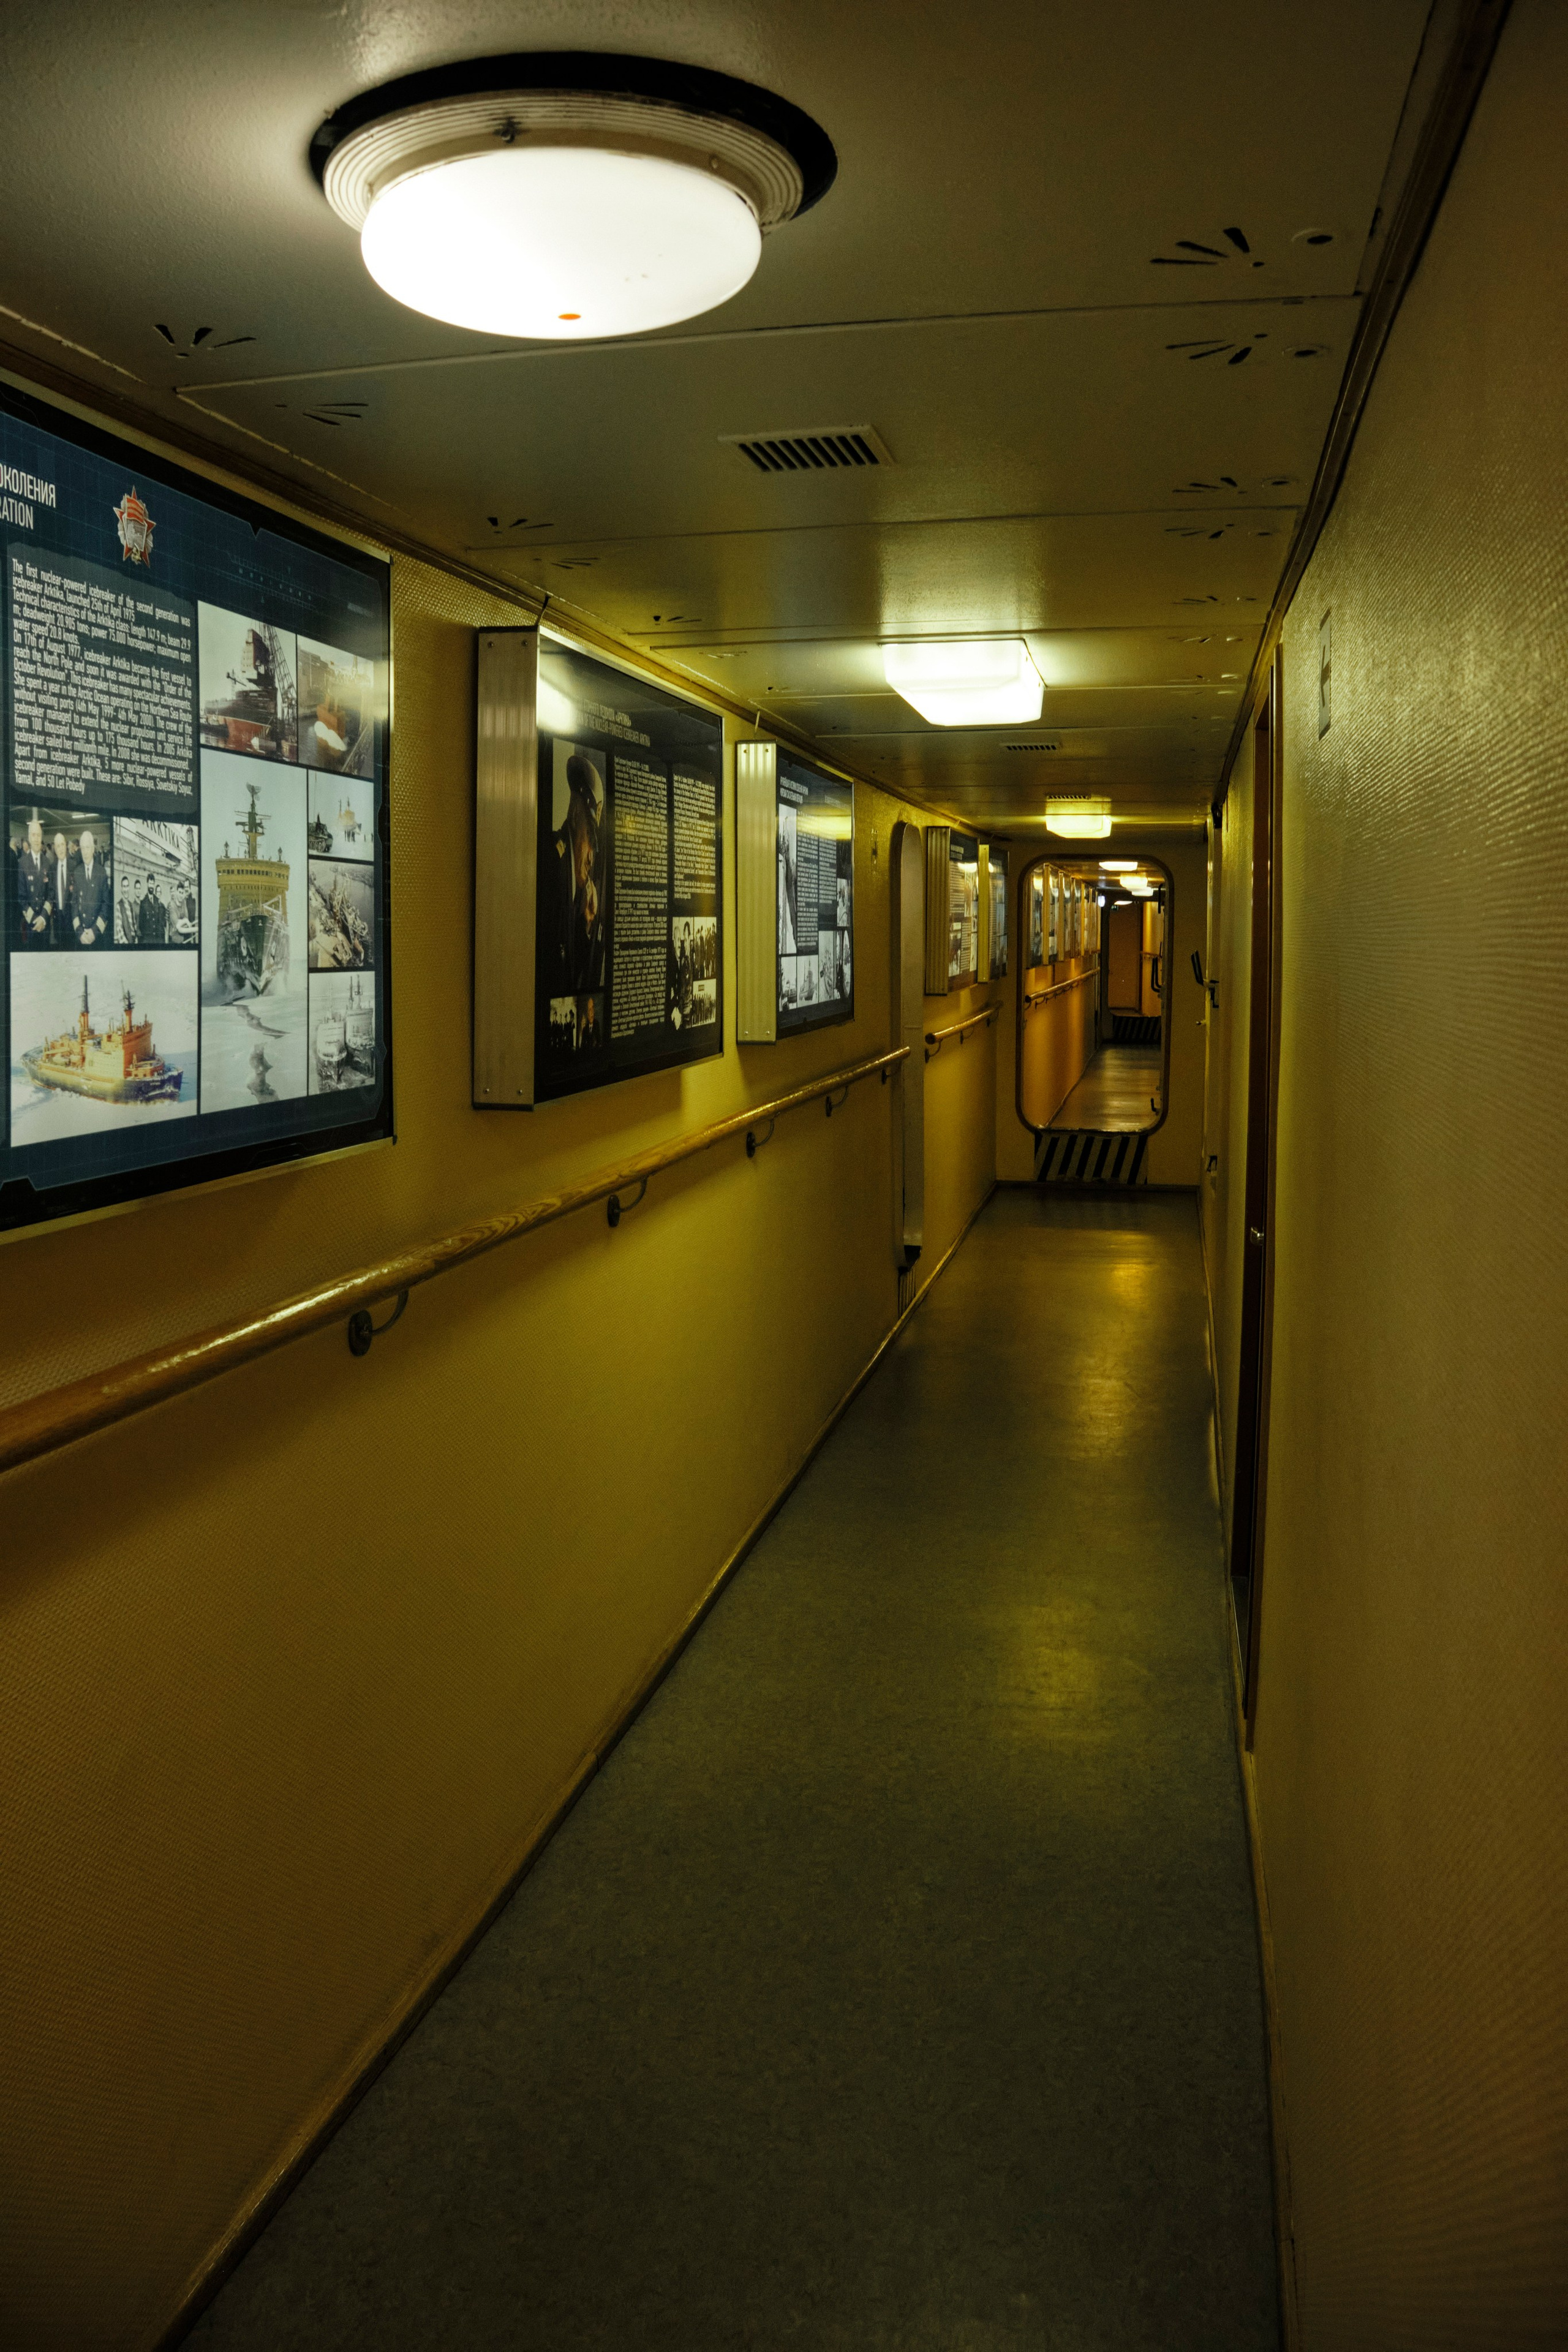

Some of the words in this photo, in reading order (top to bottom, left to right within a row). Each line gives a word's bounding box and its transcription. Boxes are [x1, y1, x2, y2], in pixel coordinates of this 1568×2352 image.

[0, 495, 33, 530] ATION
[12, 558, 23, 574] The
[26, 562, 37, 579] first
[40, 570, 86, 594] nuclear-powered
[89, 583, 115, 603] icebreaker
[118, 594, 123, 606] of
[137, 601, 153, 615] second
[155, 608, 178, 624] generation
[181, 616, 190, 627] was
[12, 572, 42, 594] icebreaker
[66, 589, 89, 608] launched
[91, 597, 102, 612] 25th
[104, 601, 108, 614] of
[110, 603, 121, 619] April
[123, 607, 134, 622] 1975
[13, 586, 39, 606] Technical
[40, 595, 79, 618] characteristics
[80, 608, 86, 620] of
[97, 611, 115, 628] Arktika
[130, 622, 146, 638] length
[147, 627, 159, 641] 147.9
[168, 633, 179, 647] beam
[181, 637, 190, 650] 29.9
[13, 617, 29, 631] water
[31, 622, 48, 636] speed
[50, 624, 61, 640] 20.8
[62, 628, 79, 644] knots.
[23, 603, 55, 626] deadweight
[57, 613, 75, 630] 20.905
[91, 626, 107, 639] power
[180, 651, 190, 663] open
[13, 628, 21, 643] On
[24, 631, 36, 647] 17th
[39, 636, 44, 649] of
[47, 638, 65, 655] August
[84, 647, 110, 666] icebreaker
[112, 655, 129, 671] Arktika
[131, 660, 149, 676] became
[160, 668, 170, 681] first
[171, 673, 185, 685] vessel
[187, 676, 191, 686] to
[13, 646, 29, 659] reach
[32, 648, 41, 662] the
[43, 650, 59, 666] North
[61, 655, 72, 669] Pole
[74, 660, 84, 673] and
[86, 664, 98, 676] soon
[106, 669, 116, 680] was
[141, 676, 151, 688] with
[178, 685, 183, 696] of
[13, 657, 36, 674] October
[70, 671, 80, 685] This
[81, 673, 108, 691] icebreaker
[109, 680, 118, 693] has
[119, 685, 132, 699] many
[14, 671, 24, 686] She
[26, 677, 42, 690] spent
[43, 680, 47, 690] a
[48, 682, 59, 694] year
[61, 682, 66, 695] in
[67, 684, 76, 697] the
[78, 685, 92, 701] Arctic
[94, 689, 109, 704] Ocean
[134, 701, 140, 711] on
[170, 707, 178, 719] Sea
[179, 709, 191, 722] Route
[14, 686, 36, 702] without
[59, 698, 74, 710] ports
[75, 698, 86, 712] (4th
[88, 701, 99, 717] May
[118, 707, 126, 720] 4th
[128, 709, 138, 725] May
[165, 720, 177, 731] crew
[178, 721, 183, 732] of
[14, 699, 44, 717] icebreaker
[47, 709, 71, 724] managed
[74, 712, 79, 724] to
[81, 715, 98, 728] extend
[110, 720, 129, 734] nuclear
[167, 732, 183, 744] service
[14, 713, 28, 728] from
[32, 717, 42, 731] 100
[44, 719, 69, 736] thousand
[72, 724, 86, 739] hours
[97, 730, 102, 742] to
[116, 733, 138, 748] thousand
[157, 741, 161, 752] In
[176, 744, 192, 758] Arktika
[14, 727, 44, 745] icebreaker
[46, 734, 62, 748] sailed
[63, 736, 72, 750] her
[111, 745, 116, 757] In
[130, 749, 139, 761] she
[140, 753, 150, 763] was
[14, 741, 30, 758] Apart
[34, 744, 47, 759] from
[50, 747, 79, 764] icebreaker
[105, 756, 108, 769] 5
[111, 761, 124, 771] more
[127, 762, 167, 778] nuclear-powered
[168, 770, 185, 781] vessels
[187, 771, 192, 782] of
[15, 758, 35, 771] second
[36, 762, 65, 775] generation
[67, 767, 80, 778] were
[96, 768, 110, 782] These
[36, 774, 46, 786] and
[47, 774, 55, 788] 50
[56, 775, 64, 789] Let
[66, 777, 85, 794] Pobedy
